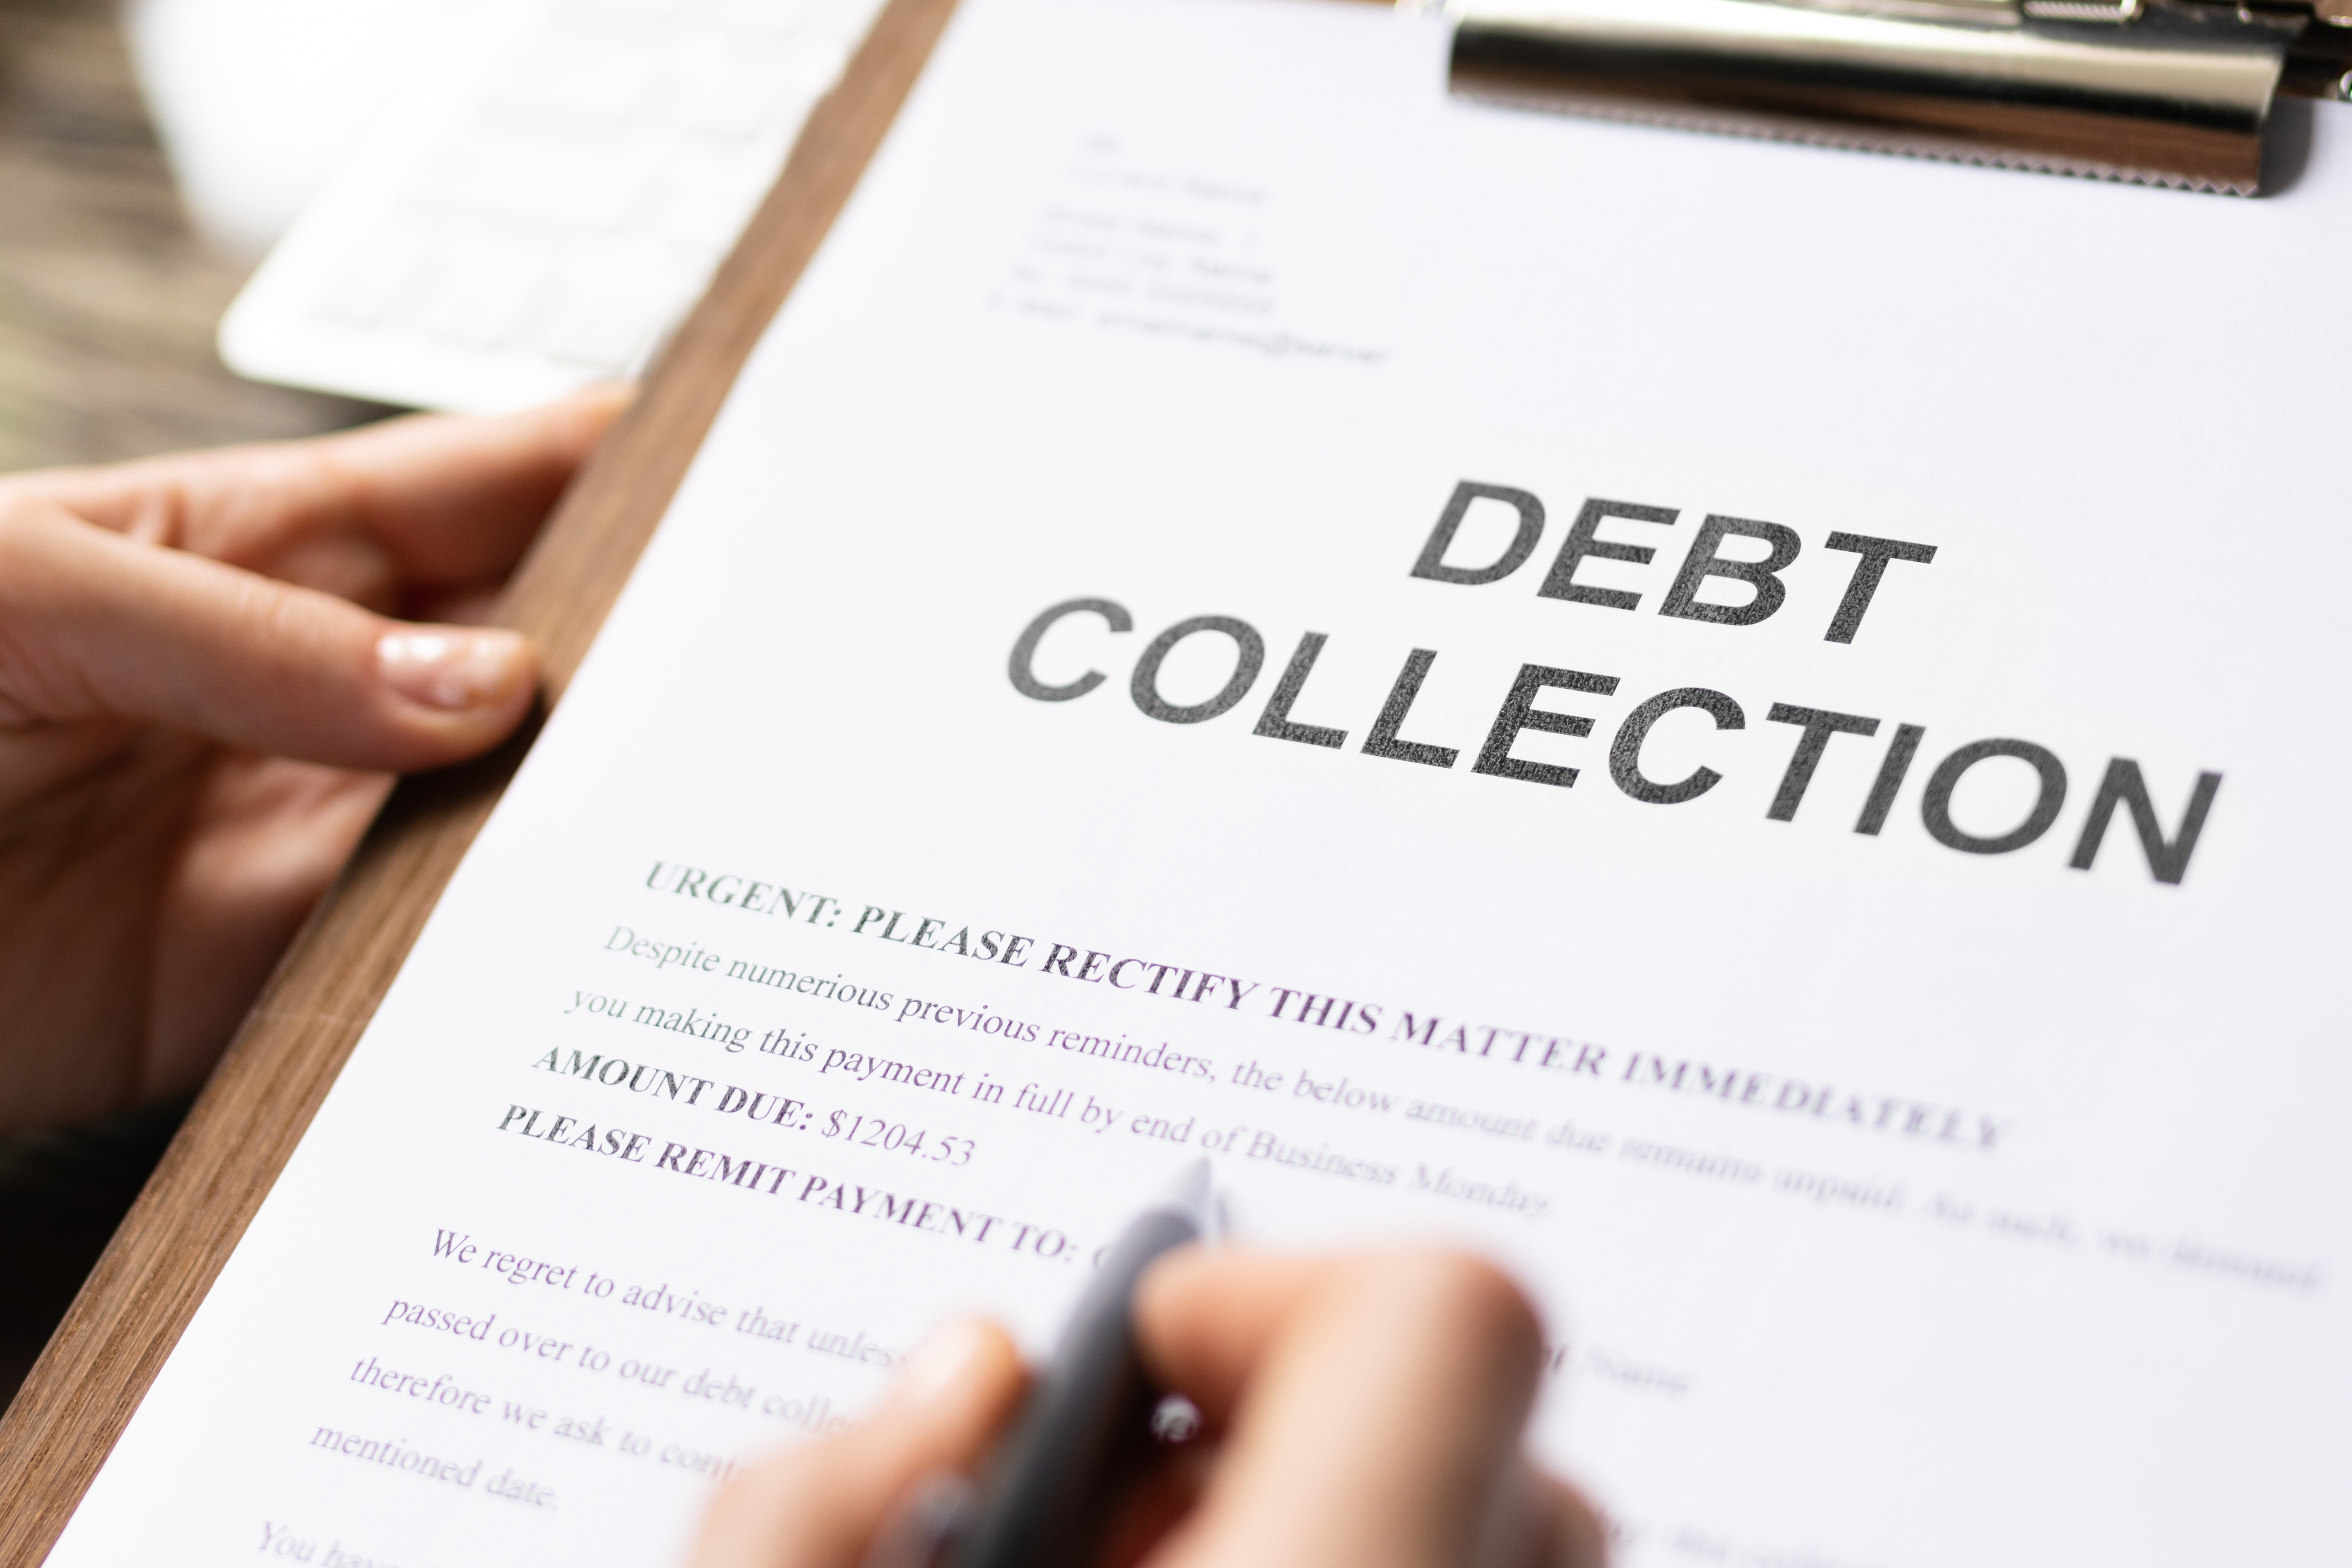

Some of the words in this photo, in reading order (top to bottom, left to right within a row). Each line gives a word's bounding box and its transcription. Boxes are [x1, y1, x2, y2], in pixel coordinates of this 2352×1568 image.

[1409, 479, 1939, 645] DEBT
[1005, 596, 2224, 887] COLLECTION
[604, 925, 721, 972] Despite
[726, 958, 894, 1011] numerious
[895, 997, 1041, 1042] previous
[1045, 1028, 1216, 1083] reminders,
[1231, 1060, 1283, 1090] the
[1293, 1069, 1401, 1113] below
[1404, 1097, 1539, 1140] amount
[1545, 1117, 1611, 1154] due
[1618, 1135, 1763, 1185] remains
[645, 861, 842, 927] URGENT:
[850, 905, 1035, 967] PLEASE
[1038, 943, 1260, 1009] RECTIFY
[1268, 987, 1383, 1034] THIS
[1390, 1010, 1608, 1075] MATTER
[1620, 1052, 2015, 1152] IMMEDIATELY
[532, 1046, 715, 1106] AMOUNT
[714, 1085, 813, 1131] DUE:
[821, 1109, 976, 1166] $1204.53
[564, 991, 628, 1017] you
[632, 1004, 754, 1053] making
[759, 1029, 819, 1062] this
[819, 1048, 966, 1095] payment
[970, 1072, 1003, 1103] in
[1011, 1083, 1075, 1118] full
[1080, 1096, 1125, 1134] by
[1131, 1116, 1195, 1143] end
[1201, 1125, 1248, 1152] of
[1246, 1130, 1398, 1184] Business
[1408, 1161, 1556, 1221] Monday.
[496, 1104, 652, 1162] PLEASE
[653, 1142, 797, 1195] REMIT
[796, 1174, 1003, 1244] PAYMENT
[1008, 1222, 1078, 1263] TO:
[380, 1299, 496, 1340] passed
[499, 1328, 573, 1361] over
[578, 1346, 611, 1370] to
[620, 1358, 679, 1388] our
[682, 1369, 757, 1408] debt
[432, 1228, 477, 1263] We
[481, 1249, 579, 1289] regret
[583, 1271, 615, 1297] to
[623, 1284, 728, 1326] advise
[736, 1306, 800, 1343] that
[309, 1424, 484, 1489] mentioned
[485, 1467, 558, 1512] date.
[351, 1356, 492, 1414] therefore
[502, 1400, 547, 1429] we
[553, 1416, 612, 1447] ask
[619, 1431, 652, 1455] to
[661, 1443, 744, 1483] cont
[258, 1519, 318, 1561] You
[321, 1539, 402, 1568] hav
